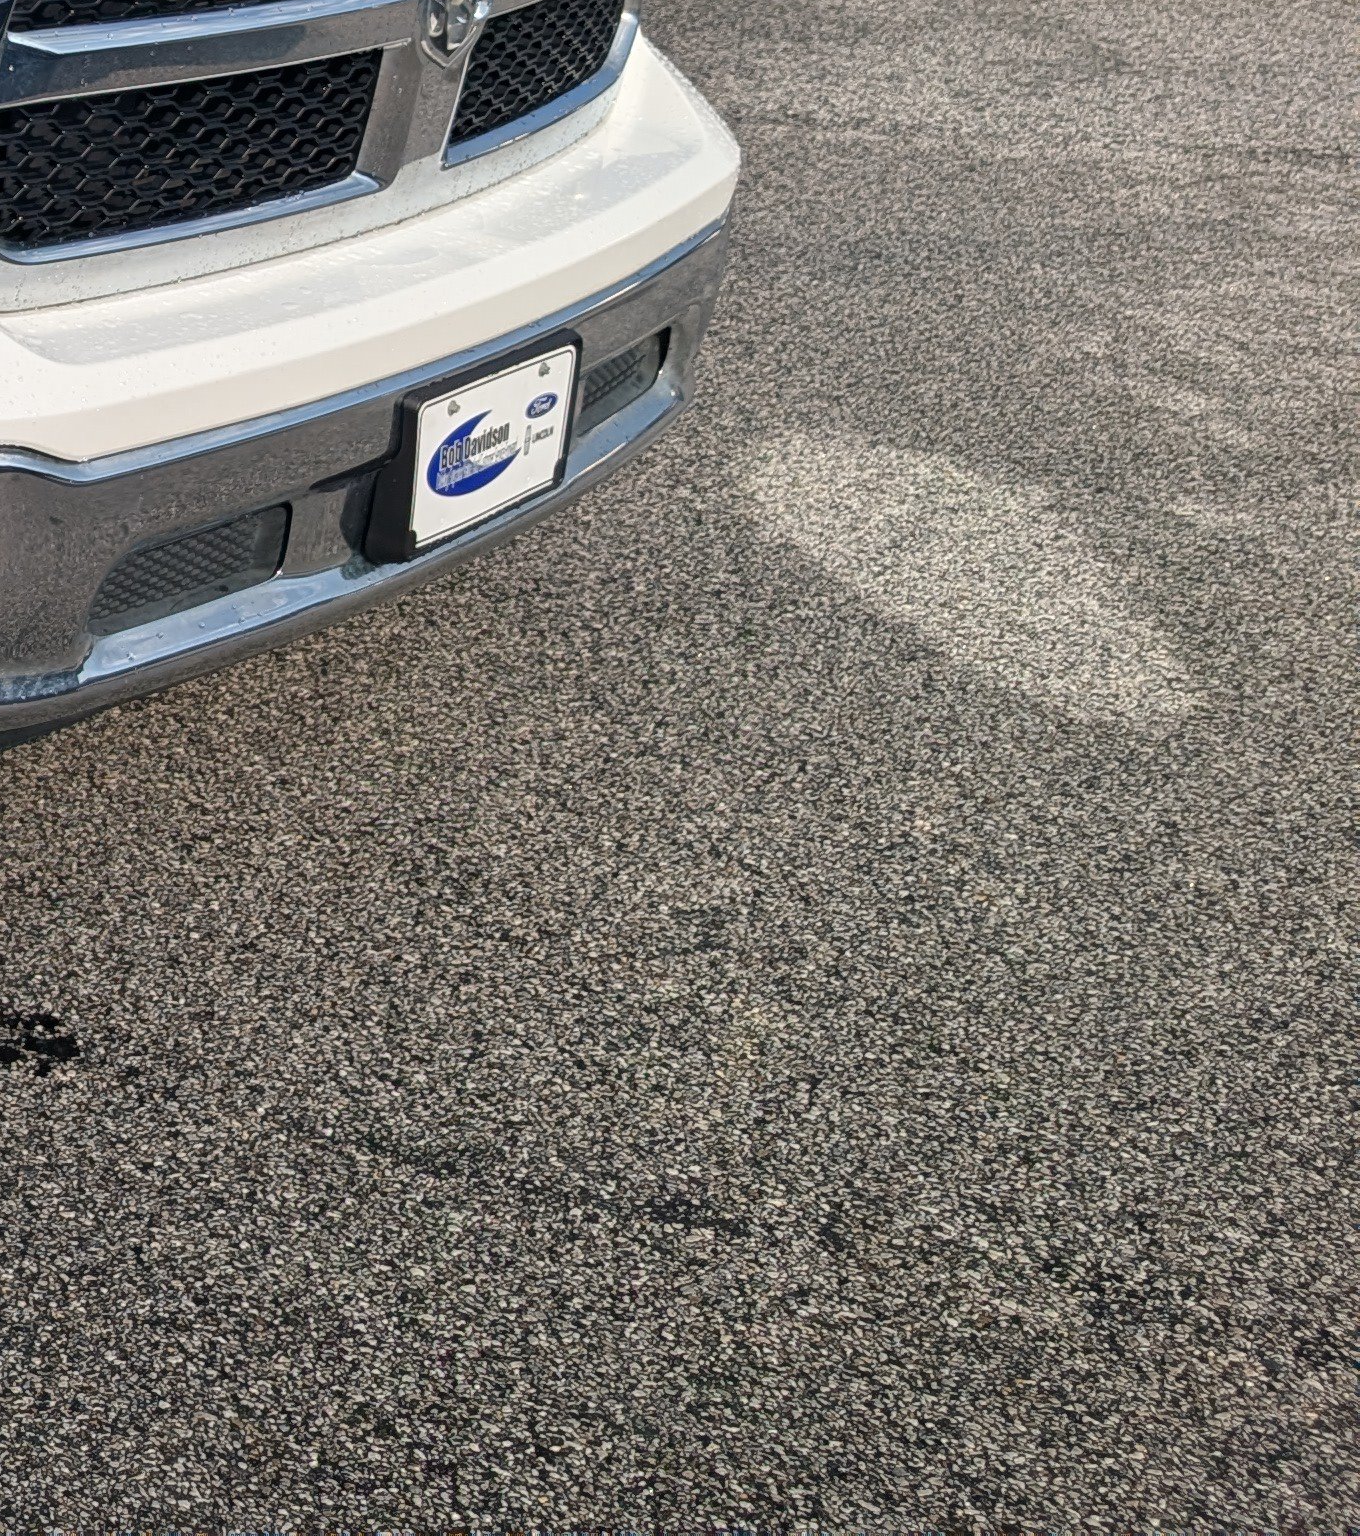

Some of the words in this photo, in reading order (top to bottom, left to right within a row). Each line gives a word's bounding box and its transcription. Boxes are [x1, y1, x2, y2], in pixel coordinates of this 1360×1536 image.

[529, 394, 556, 418] Ford
[439, 438, 464, 470] Bob
[463, 422, 511, 460] Davidson
